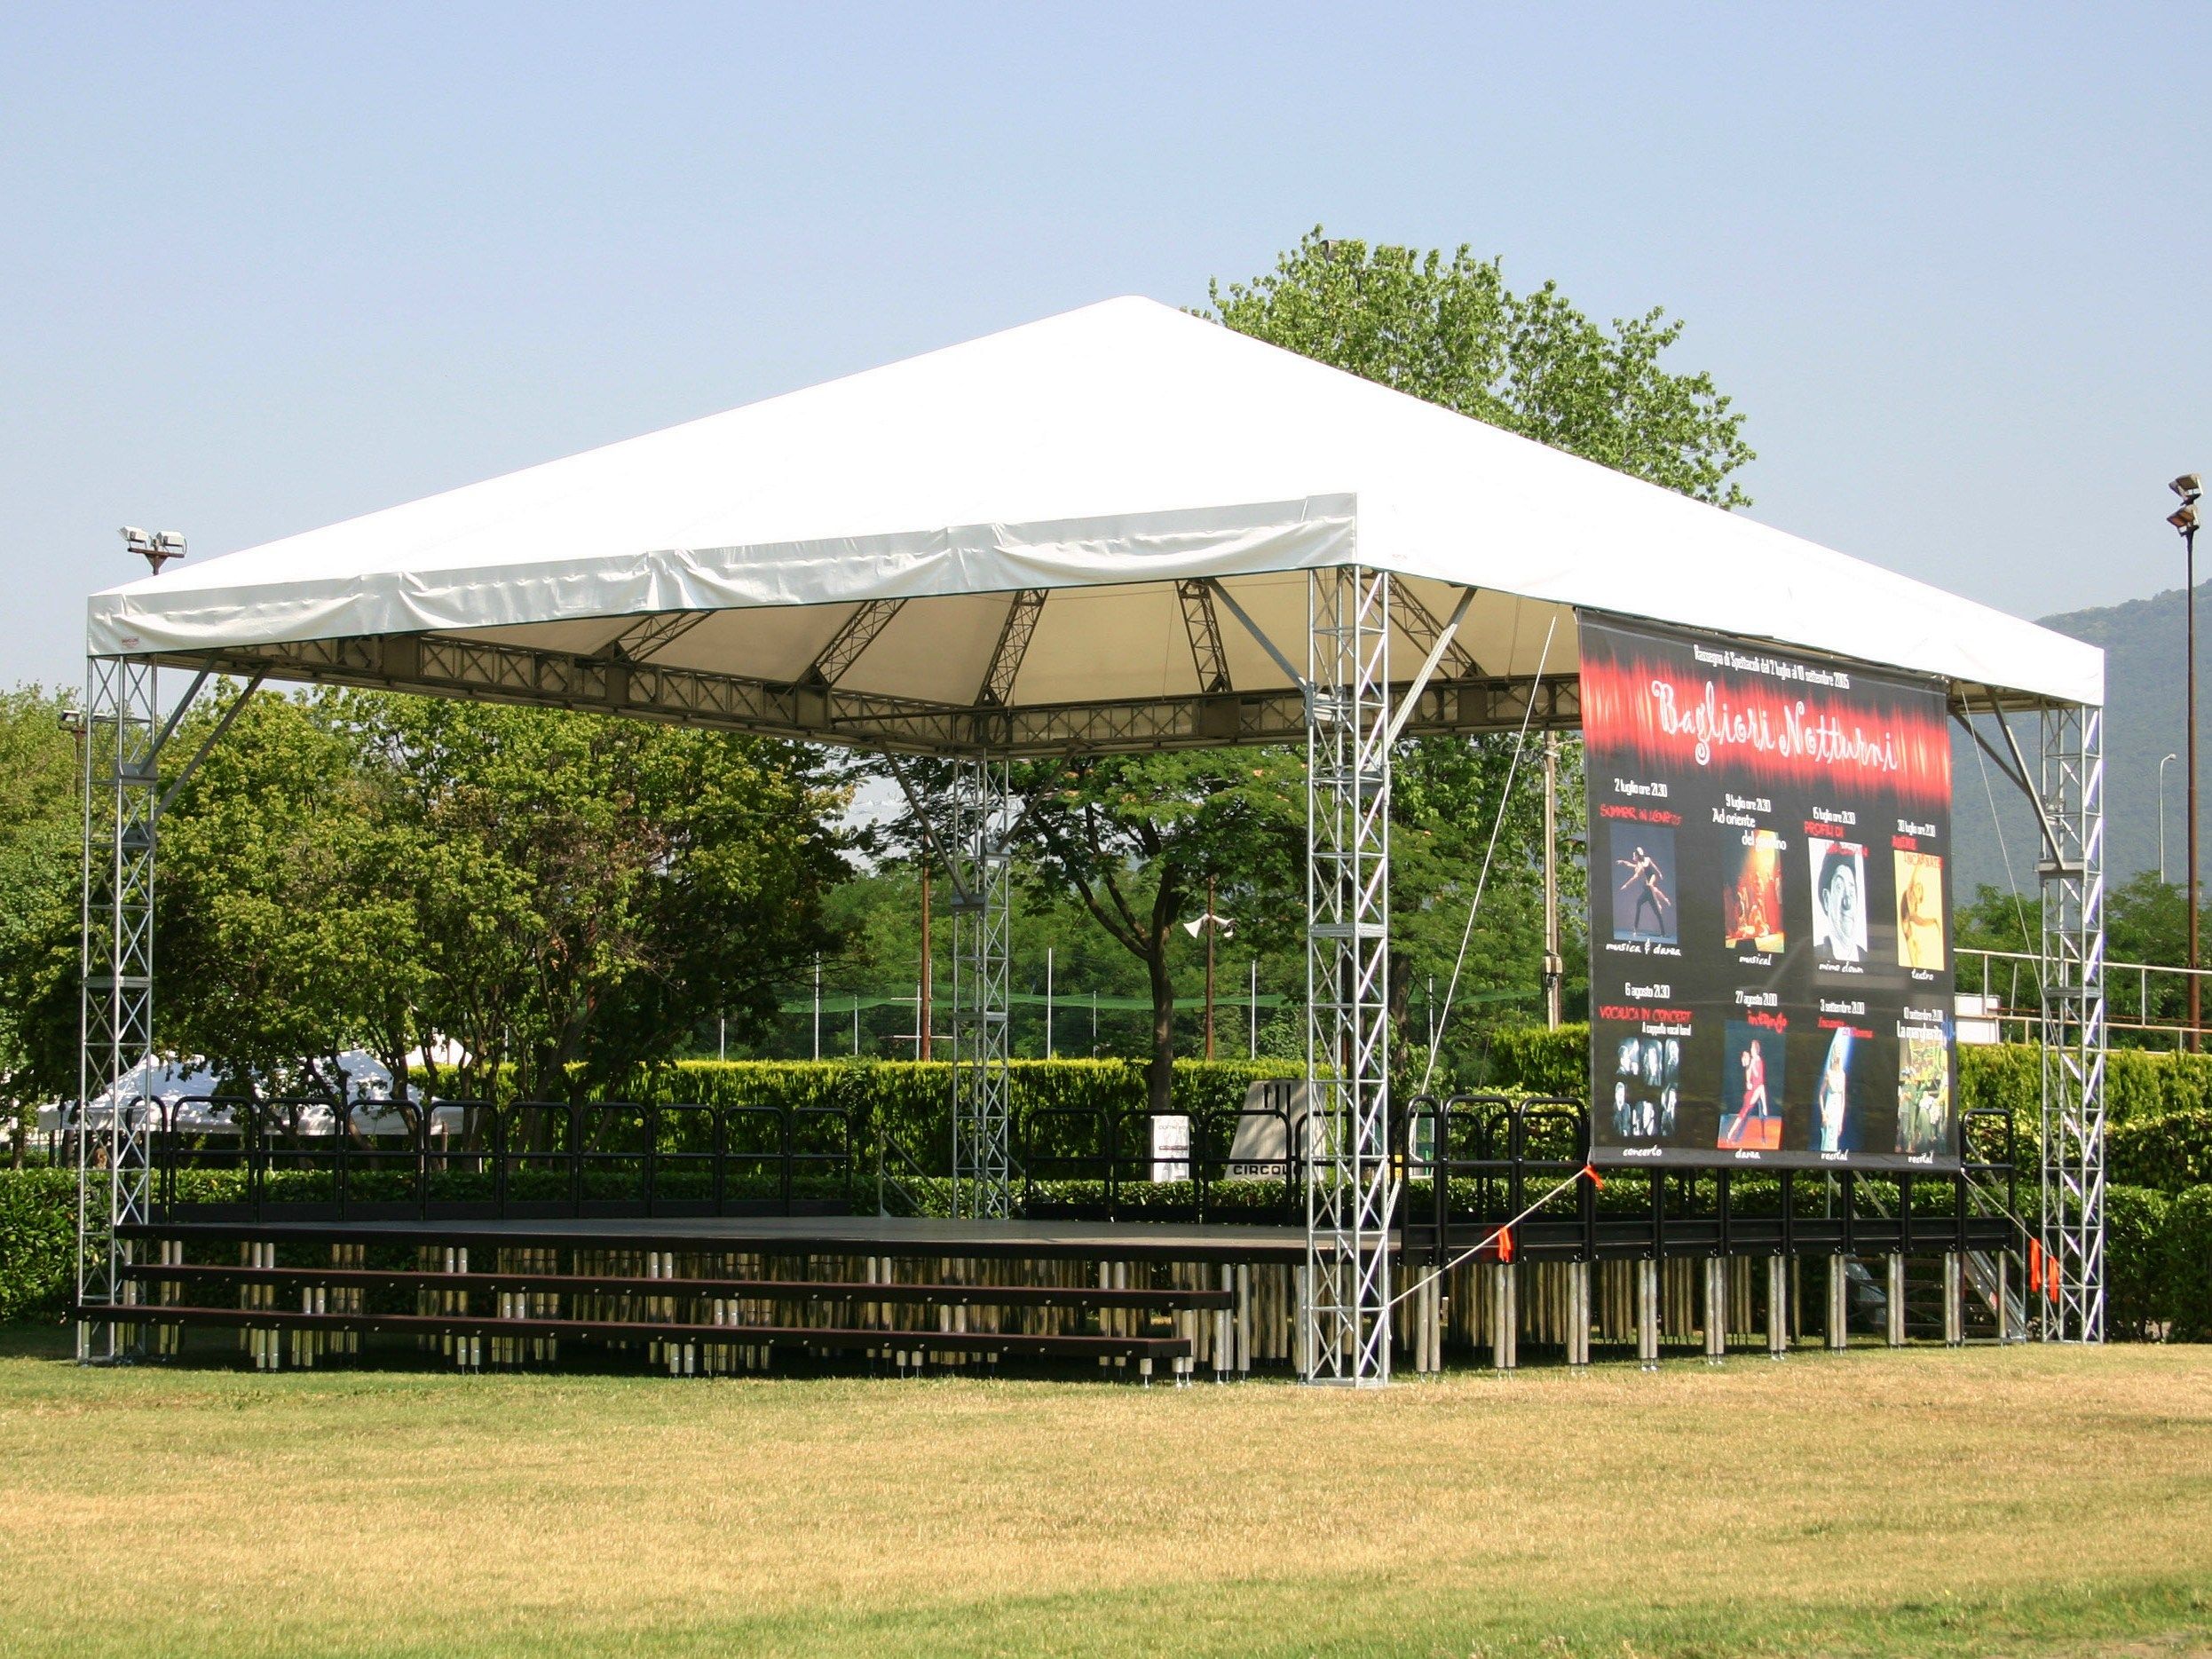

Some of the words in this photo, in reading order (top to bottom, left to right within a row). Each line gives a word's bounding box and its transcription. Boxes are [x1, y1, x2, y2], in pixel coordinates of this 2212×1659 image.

[1724, 651, 1730, 667] di
[1651, 680, 1774, 765] Bagliori
[1779, 701, 1898, 771] Notturni
[1615, 778, 1620, 792] 2
[1620, 778, 1639, 796] luglio
[1639, 785, 1651, 795] ore
[1731, 794, 1746, 811] luglio
[1746, 801, 1757, 810] ore
[1712, 807, 1726, 824] Ad
[1726, 813, 1756, 828] oriente
[1742, 830, 1754, 846] del
[1606, 941, 1641, 953] musica
[1654, 943, 1682, 957] danza
[1739, 953, 1772, 966] musical
[1819, 960, 1840, 971] mimo
[1911, 968, 1934, 981] teatro
[1624, 982, 1631, 996] 6
[1631, 986, 1654, 999] agosto
[1653, 984, 1671, 999] 21.30
[1735, 990, 1744, 1004] 27
[1743, 994, 1763, 1007] agosto
[1820, 998, 1825, 1012] 3
[1825, 1000, 1852, 1013] settembre
[1652, 1007, 1693, 1023] CONCERT
[1897, 1019, 1906, 1038] La
[1623, 1144, 1663, 1157] concerto
[1734, 1148, 1760, 1159] danza
[1821, 1149, 1849, 1161] recital
[1908, 1149, 1933, 1164] recital
